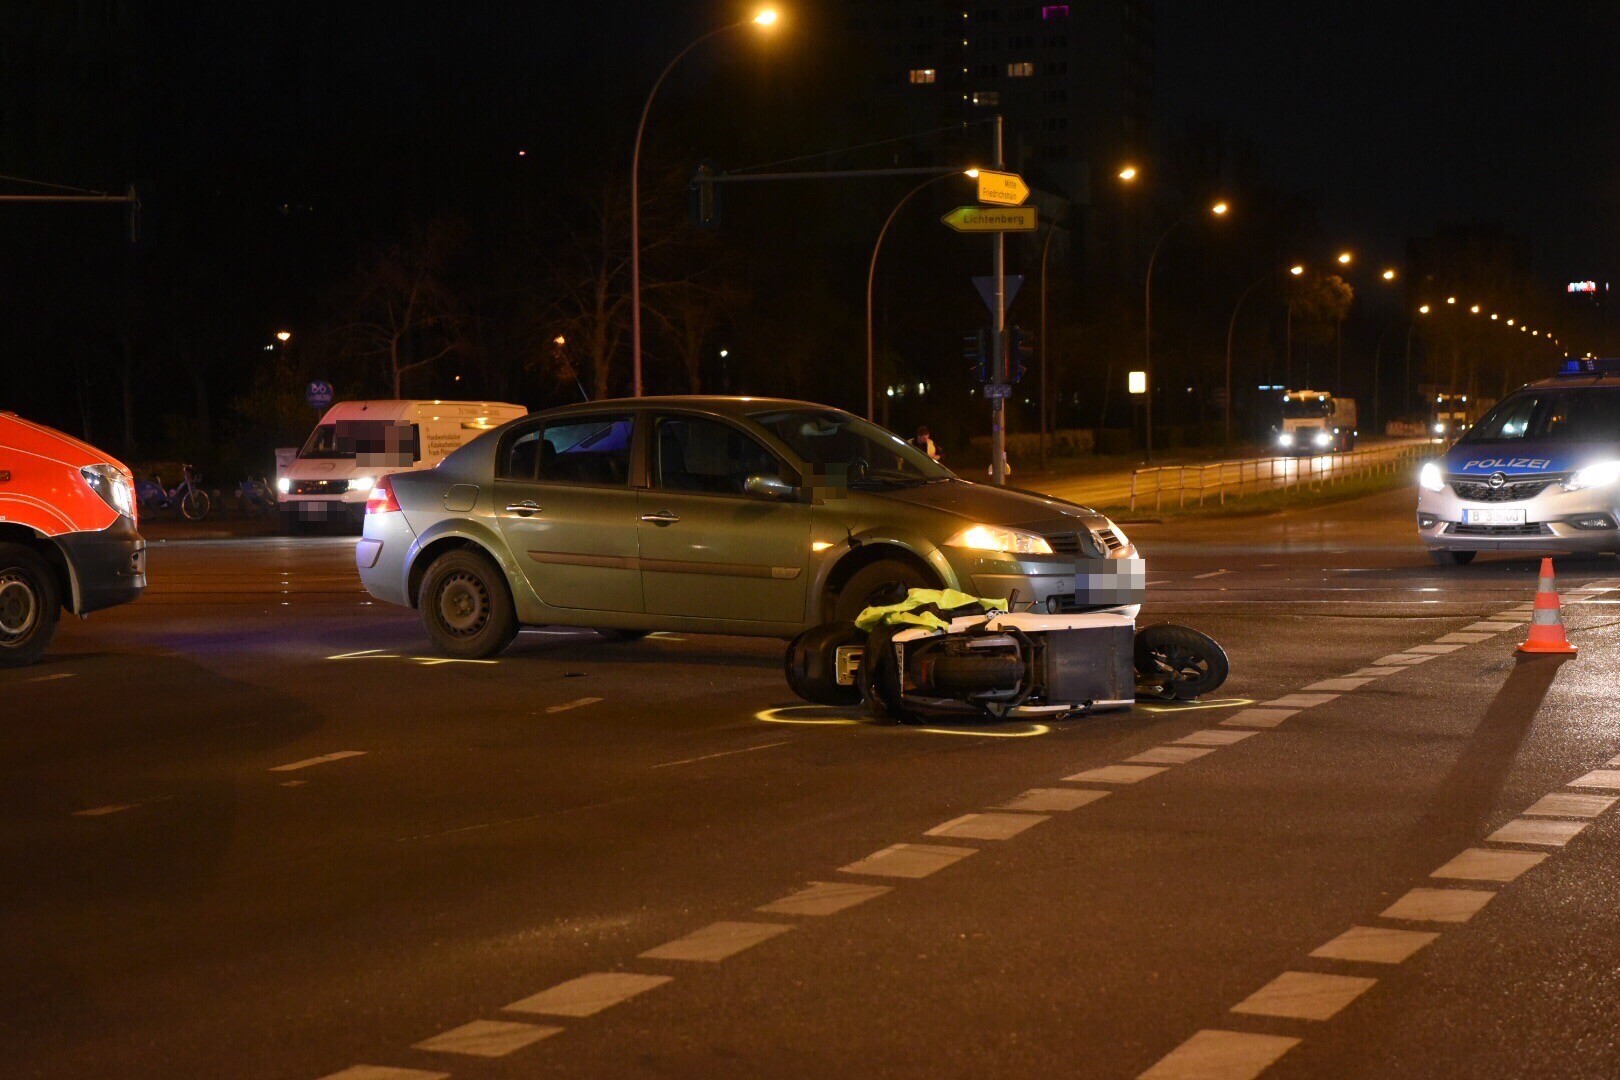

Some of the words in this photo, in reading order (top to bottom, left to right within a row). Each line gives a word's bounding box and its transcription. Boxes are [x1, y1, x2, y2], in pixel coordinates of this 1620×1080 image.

[1004, 179, 1016, 189] Mitte
[983, 188, 1016, 200] Friedrichshain
[964, 214, 1024, 224] Lichtenberg
[1463, 458, 1552, 470] POLIZEI
